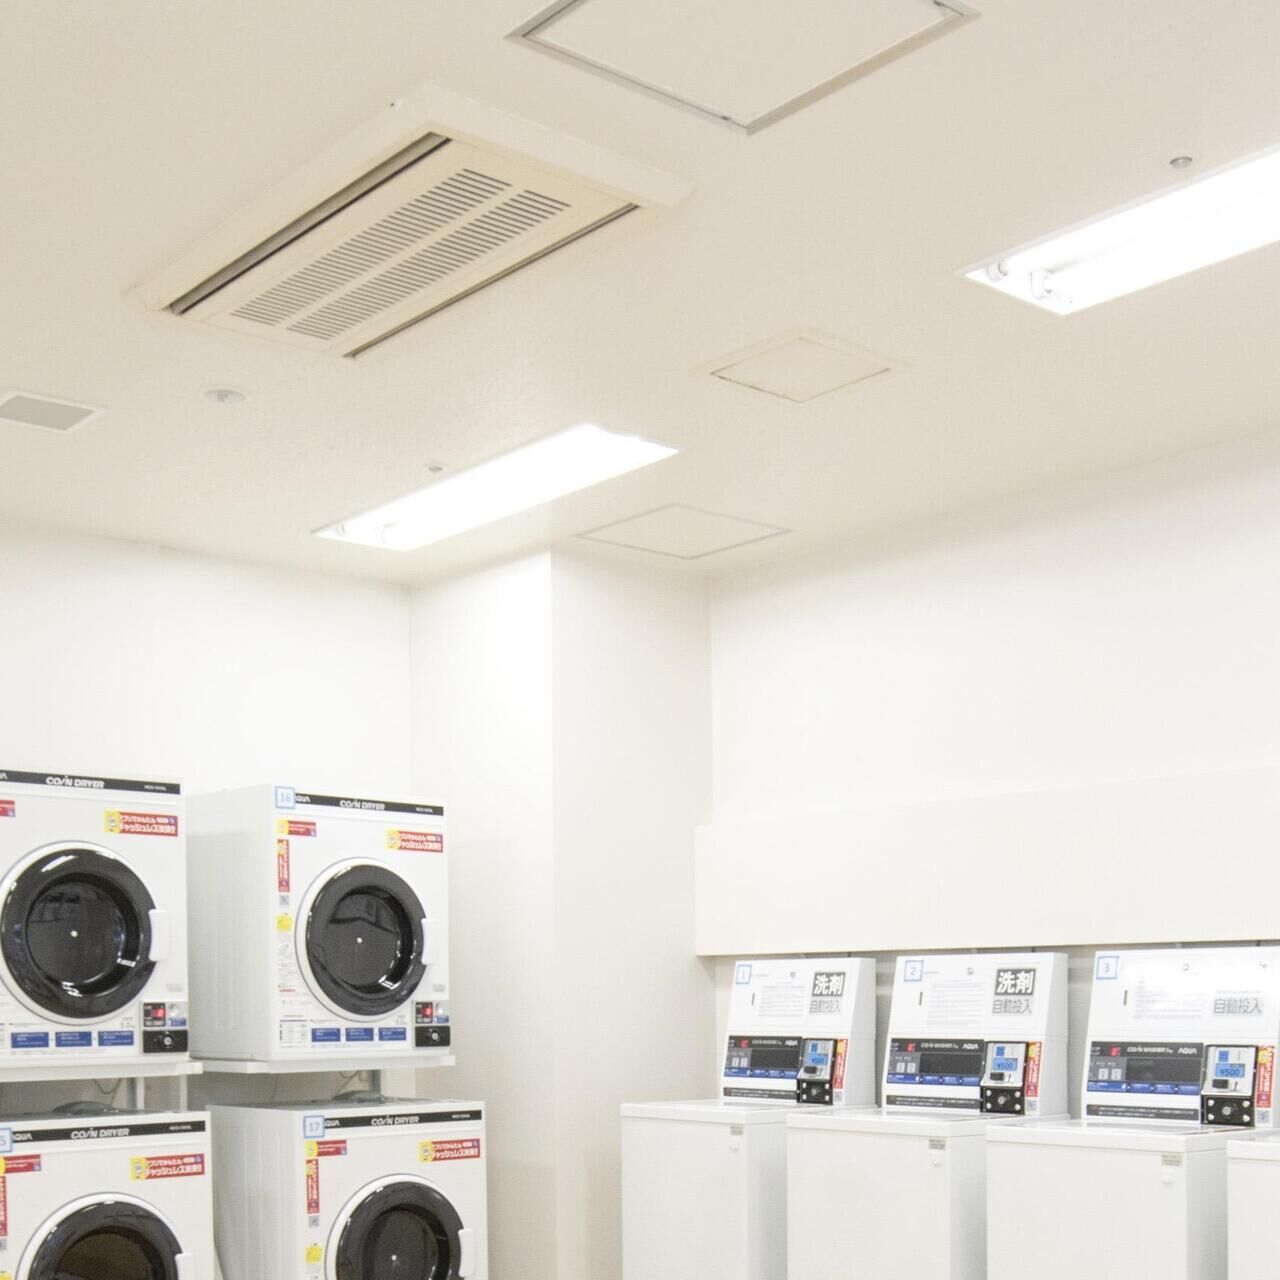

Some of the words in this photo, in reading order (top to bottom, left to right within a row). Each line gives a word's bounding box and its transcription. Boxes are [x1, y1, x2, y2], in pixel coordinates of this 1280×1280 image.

[74, 778, 105, 789] DRYER
[910, 966, 917, 976] 2
[1104, 962, 1110, 973] 3
[813, 973, 844, 995] 洗剤
[997, 970, 1034, 994] 洗剤
[1213, 998, 1262, 1015] 自動投入
[1177, 1047, 1198, 1055] AQUA
[395, 1115, 419, 1125] DRYER
[99, 1127, 130, 1138] DRYER
